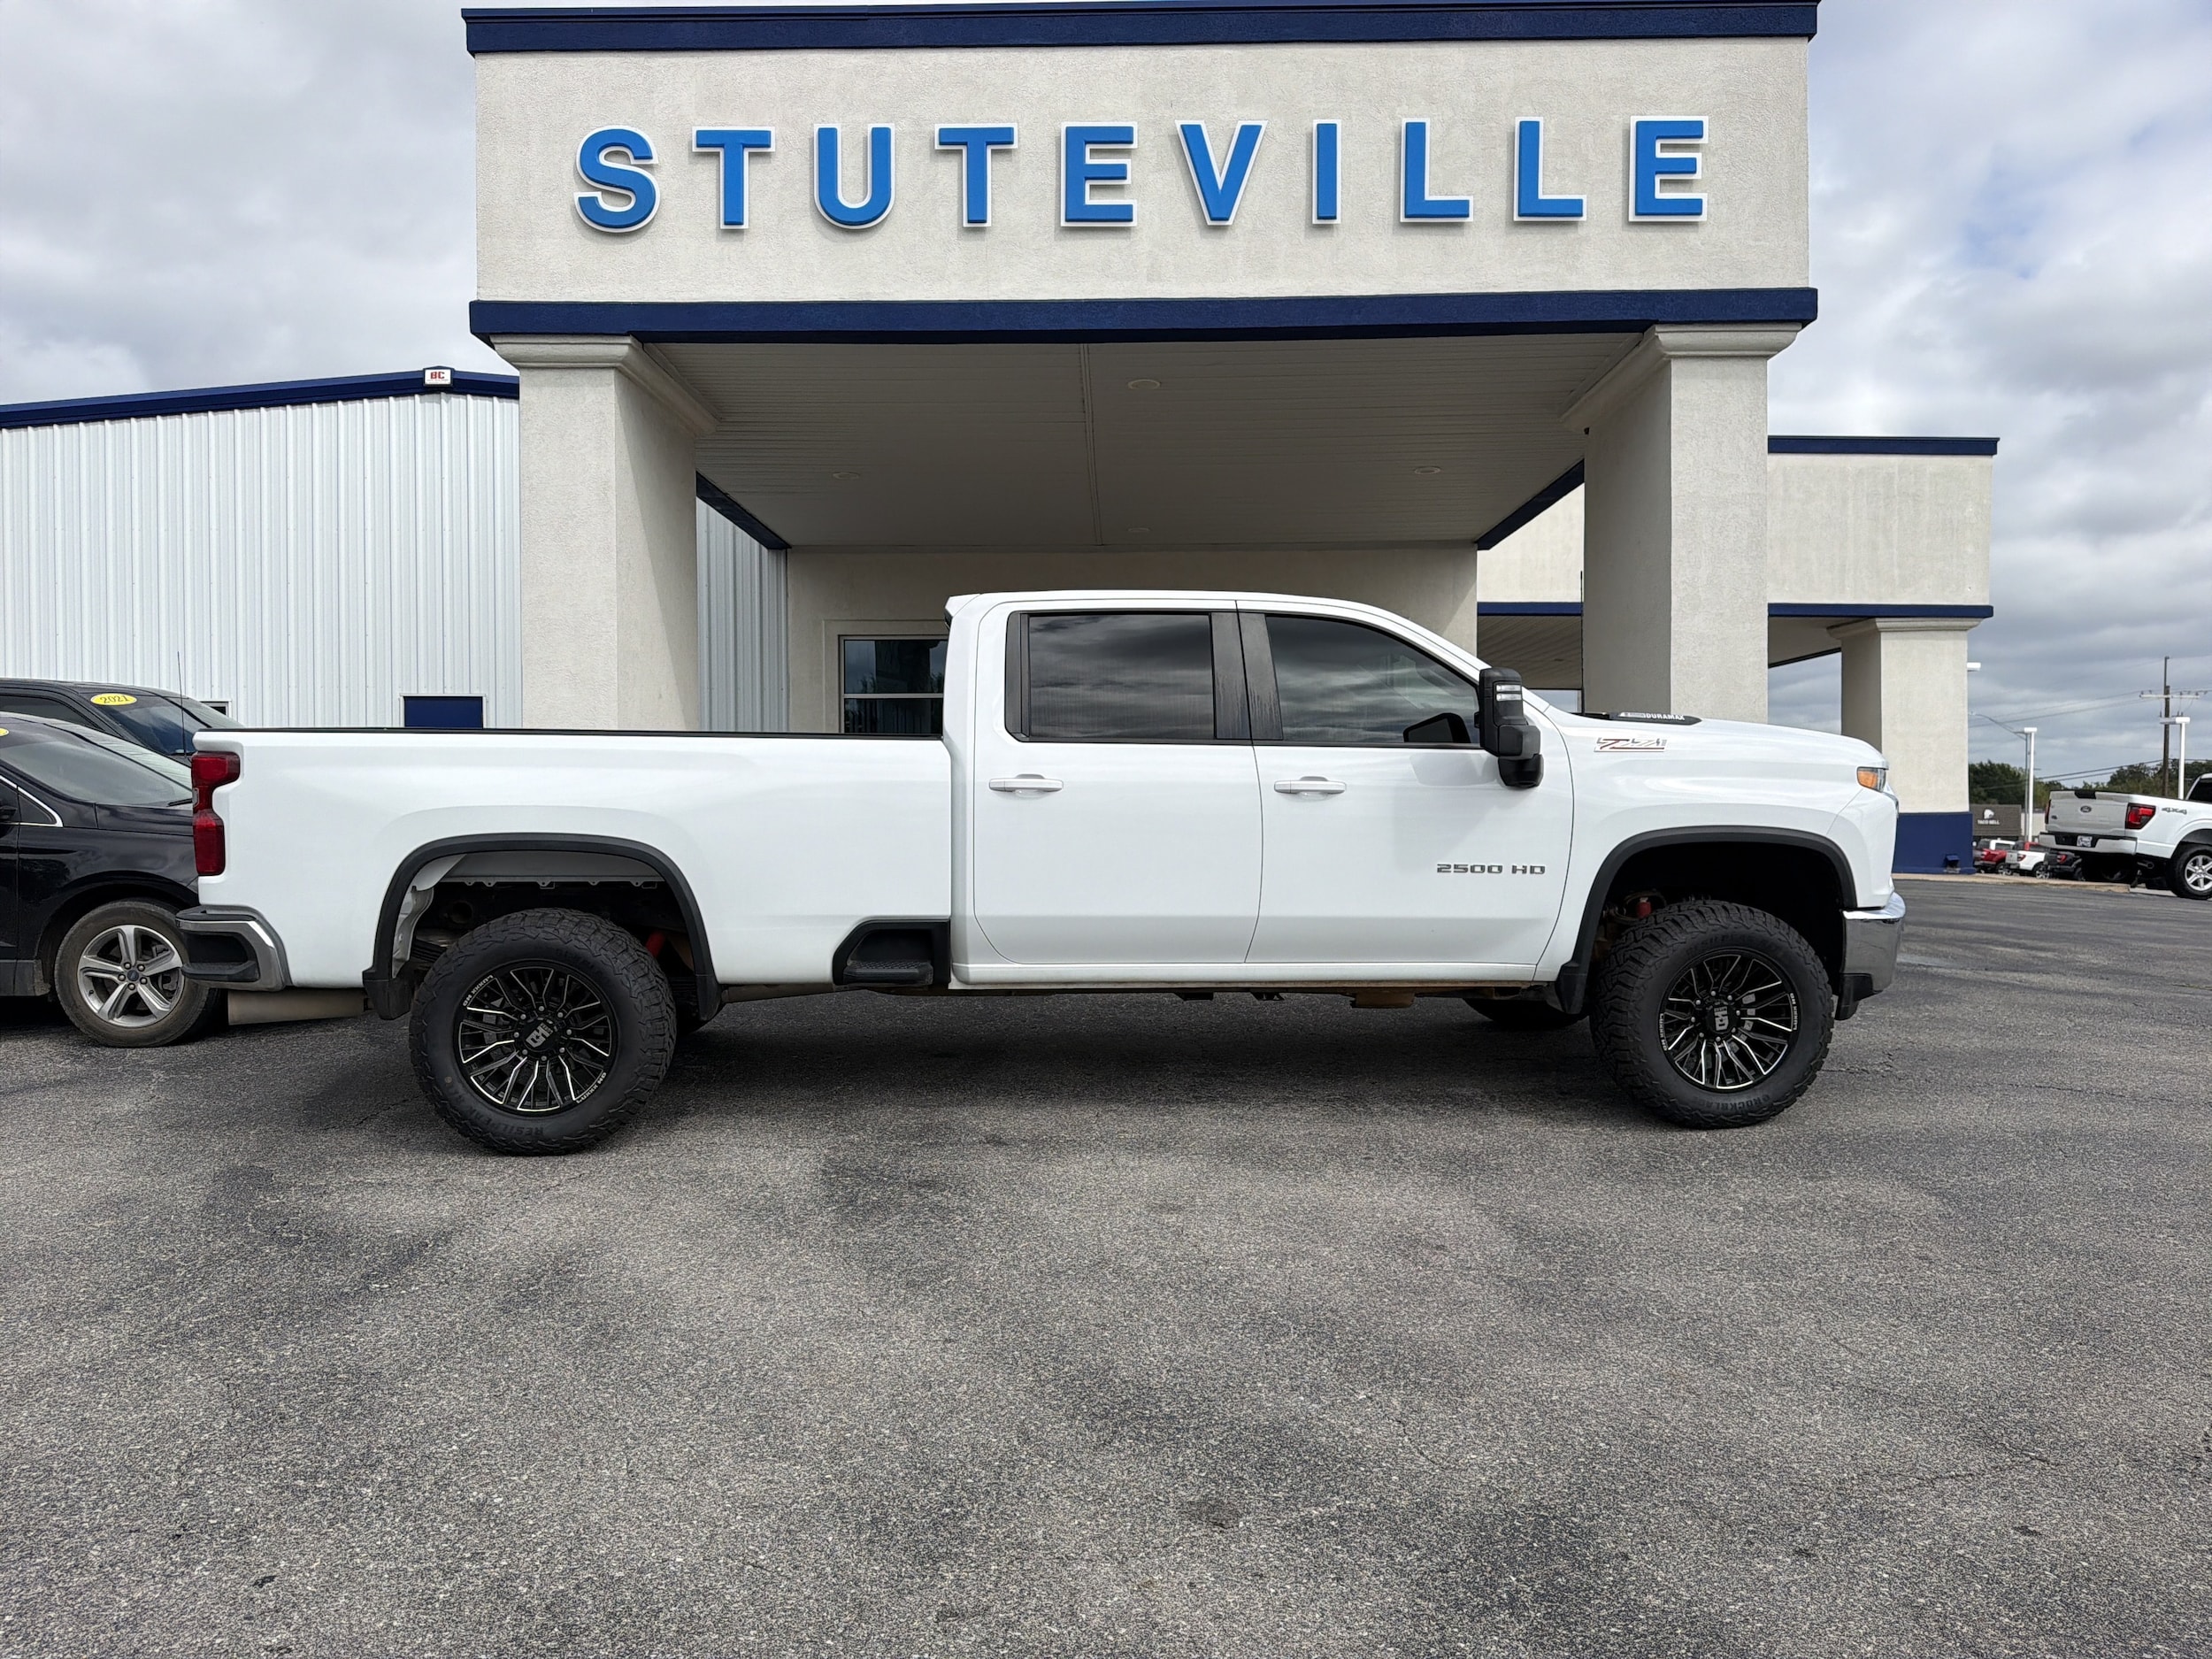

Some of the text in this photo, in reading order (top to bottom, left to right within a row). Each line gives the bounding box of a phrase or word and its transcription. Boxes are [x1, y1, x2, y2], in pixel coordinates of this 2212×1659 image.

[573, 116, 1709, 233] STUTEVILLE
[99, 695, 130, 704] 2021
[1646, 712, 1686, 721] DURAMAX
[1436, 864, 1547, 875] 2500 HD
